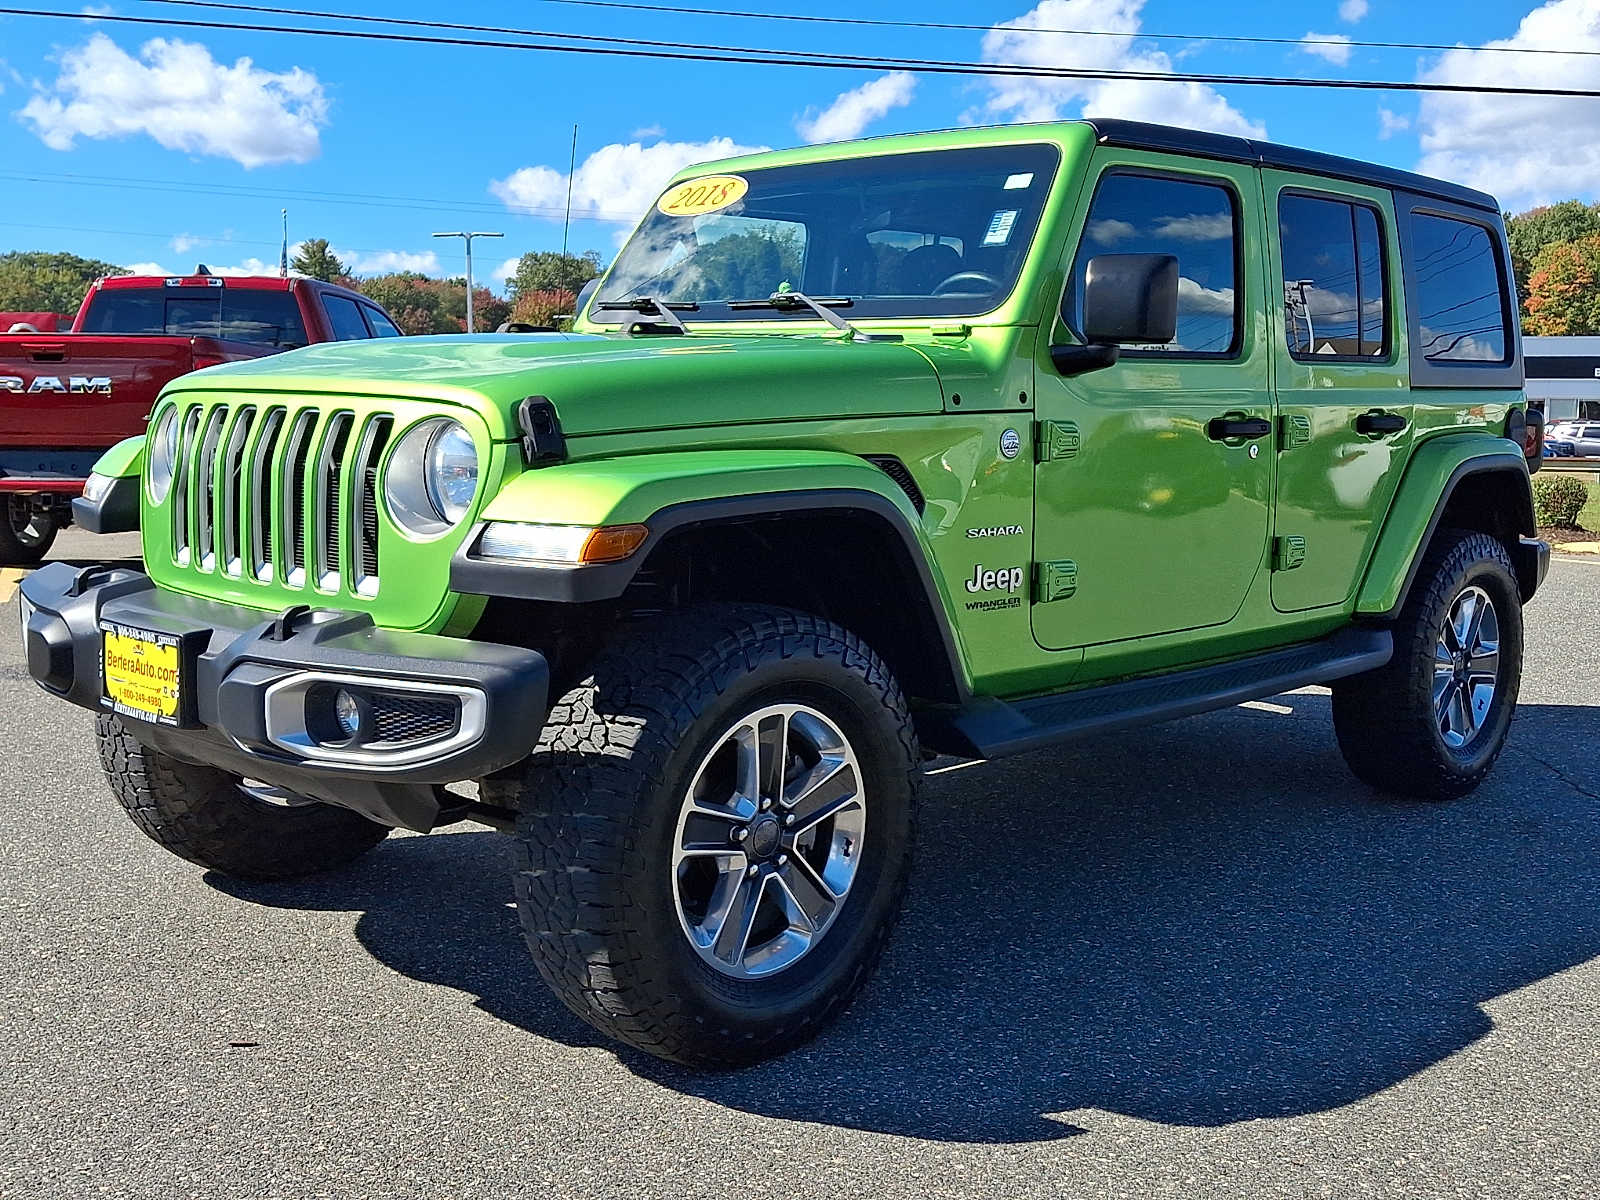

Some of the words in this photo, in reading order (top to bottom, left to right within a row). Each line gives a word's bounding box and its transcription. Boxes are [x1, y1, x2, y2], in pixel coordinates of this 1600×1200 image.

[668, 182, 736, 209] 2018
[967, 525, 1024, 538] SAHARA
[966, 564, 1023, 593] Jeep
[965, 597, 1021, 610] WRANGLER
[107, 650, 177, 682] BerteraAuto.com
